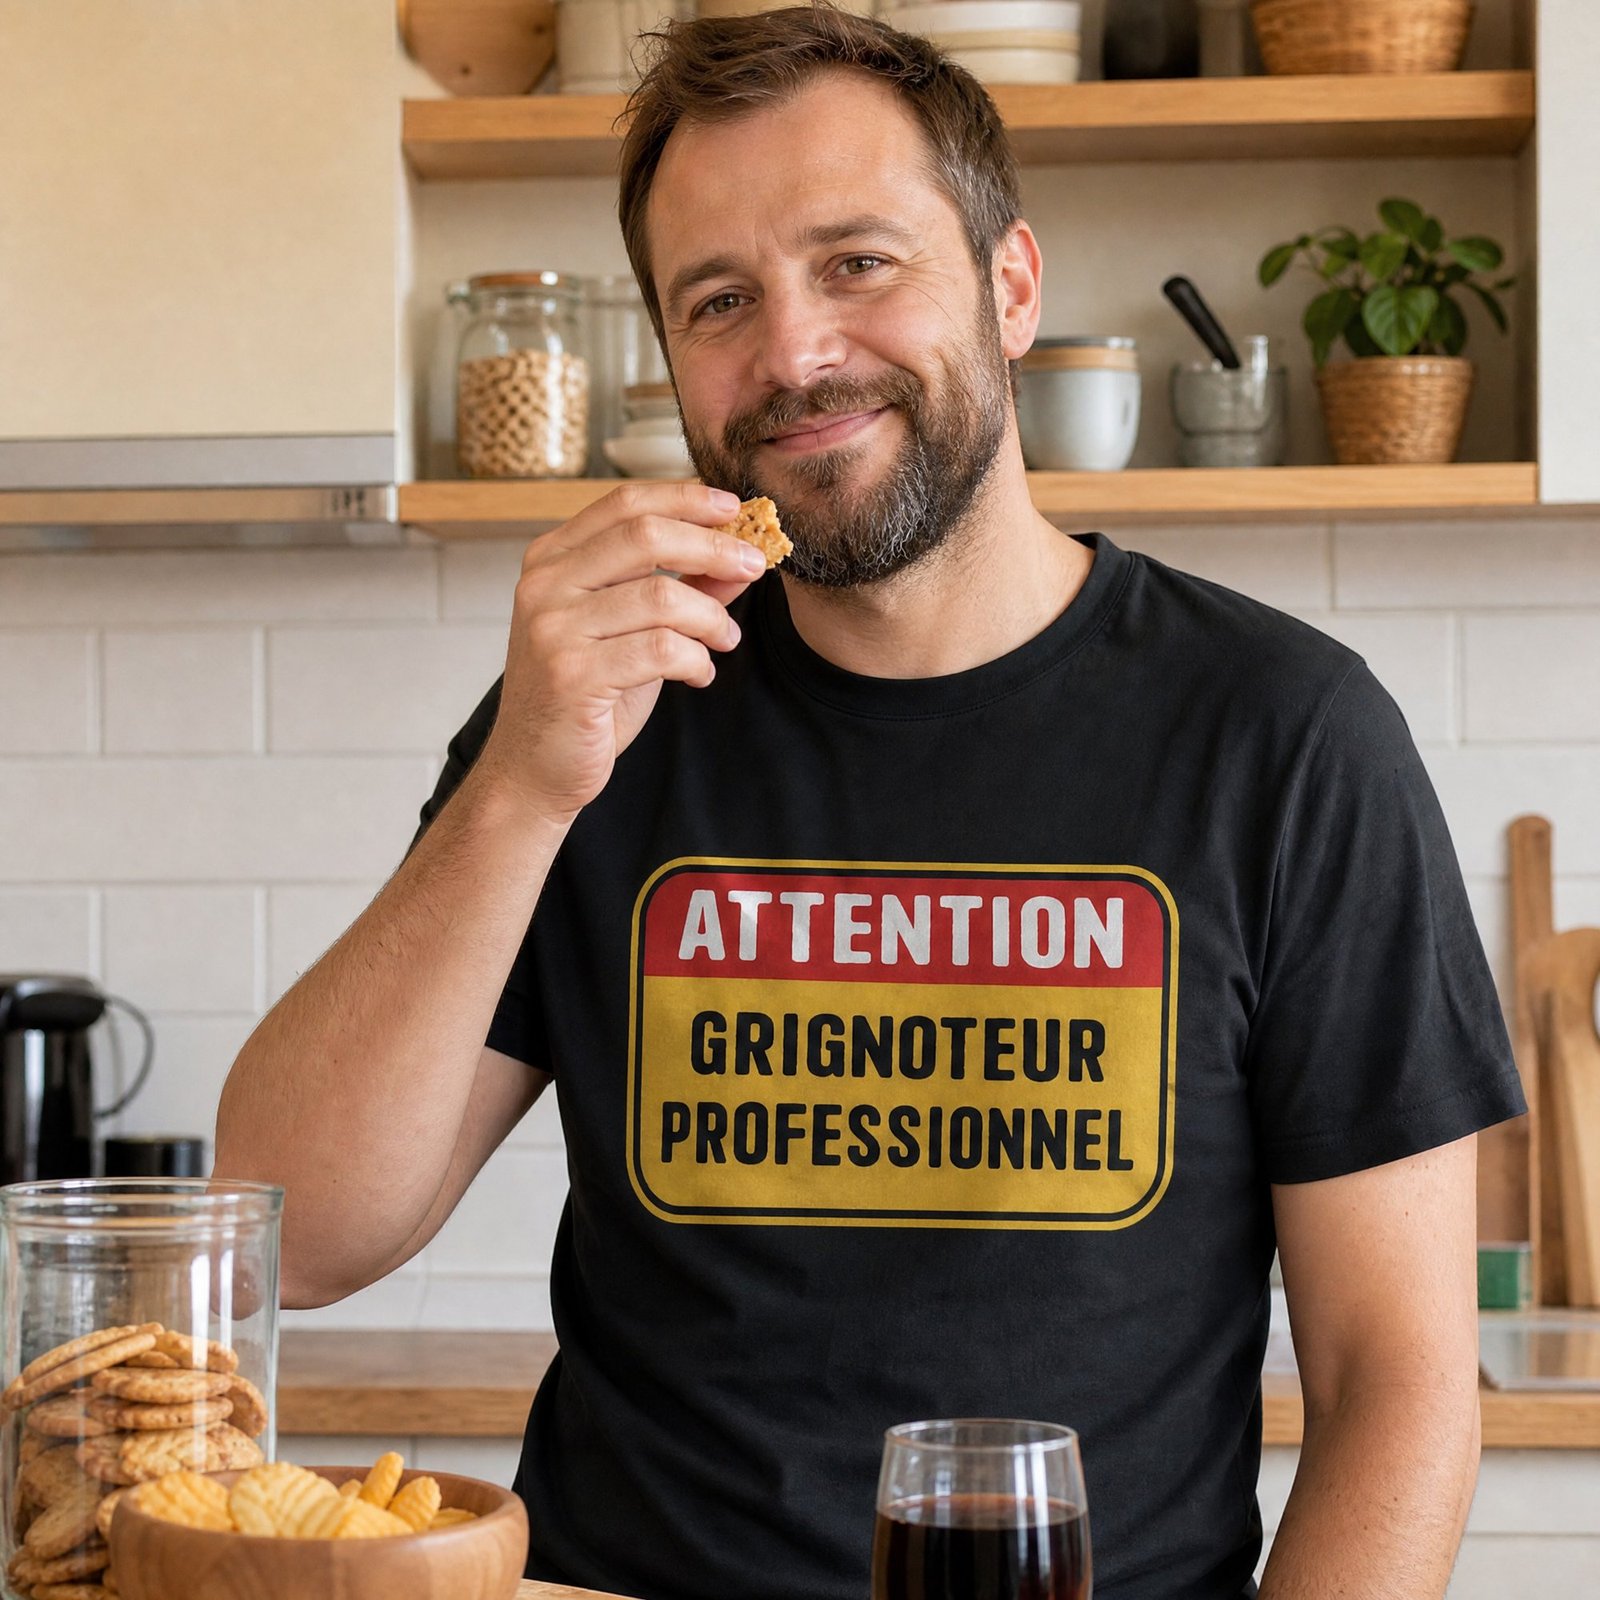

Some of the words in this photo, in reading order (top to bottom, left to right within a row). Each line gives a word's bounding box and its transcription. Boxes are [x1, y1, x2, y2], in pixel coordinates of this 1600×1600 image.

[677, 888, 1125, 970] ATTENTION
[690, 1010, 1106, 1083] GRIGNOTEUR
[660, 1100, 1135, 1172] PROFESSIONNEL
